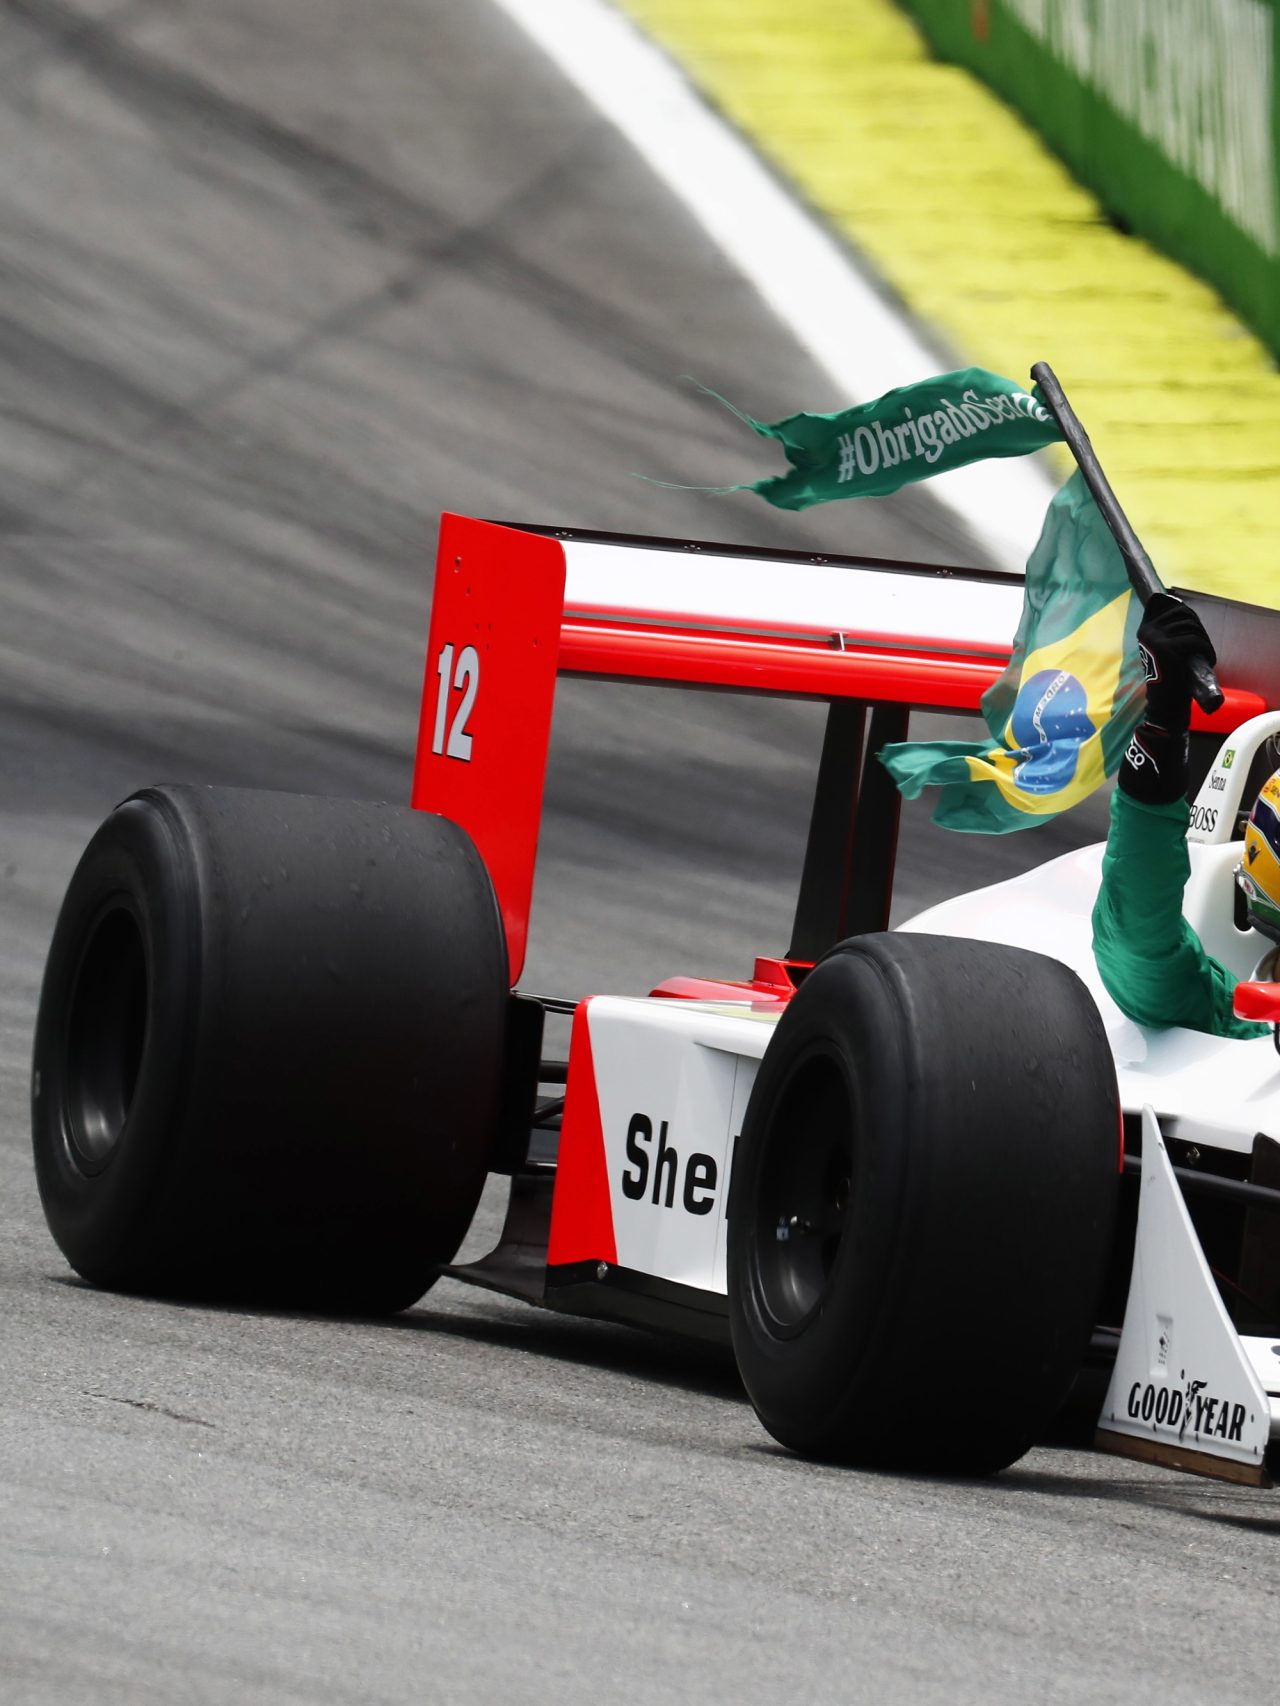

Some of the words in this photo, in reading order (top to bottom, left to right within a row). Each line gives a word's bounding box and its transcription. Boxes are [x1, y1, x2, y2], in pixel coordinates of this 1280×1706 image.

[431, 641, 480, 763] 12
[1188, 805, 1219, 832] BOSS
[621, 1112, 740, 1219] She
